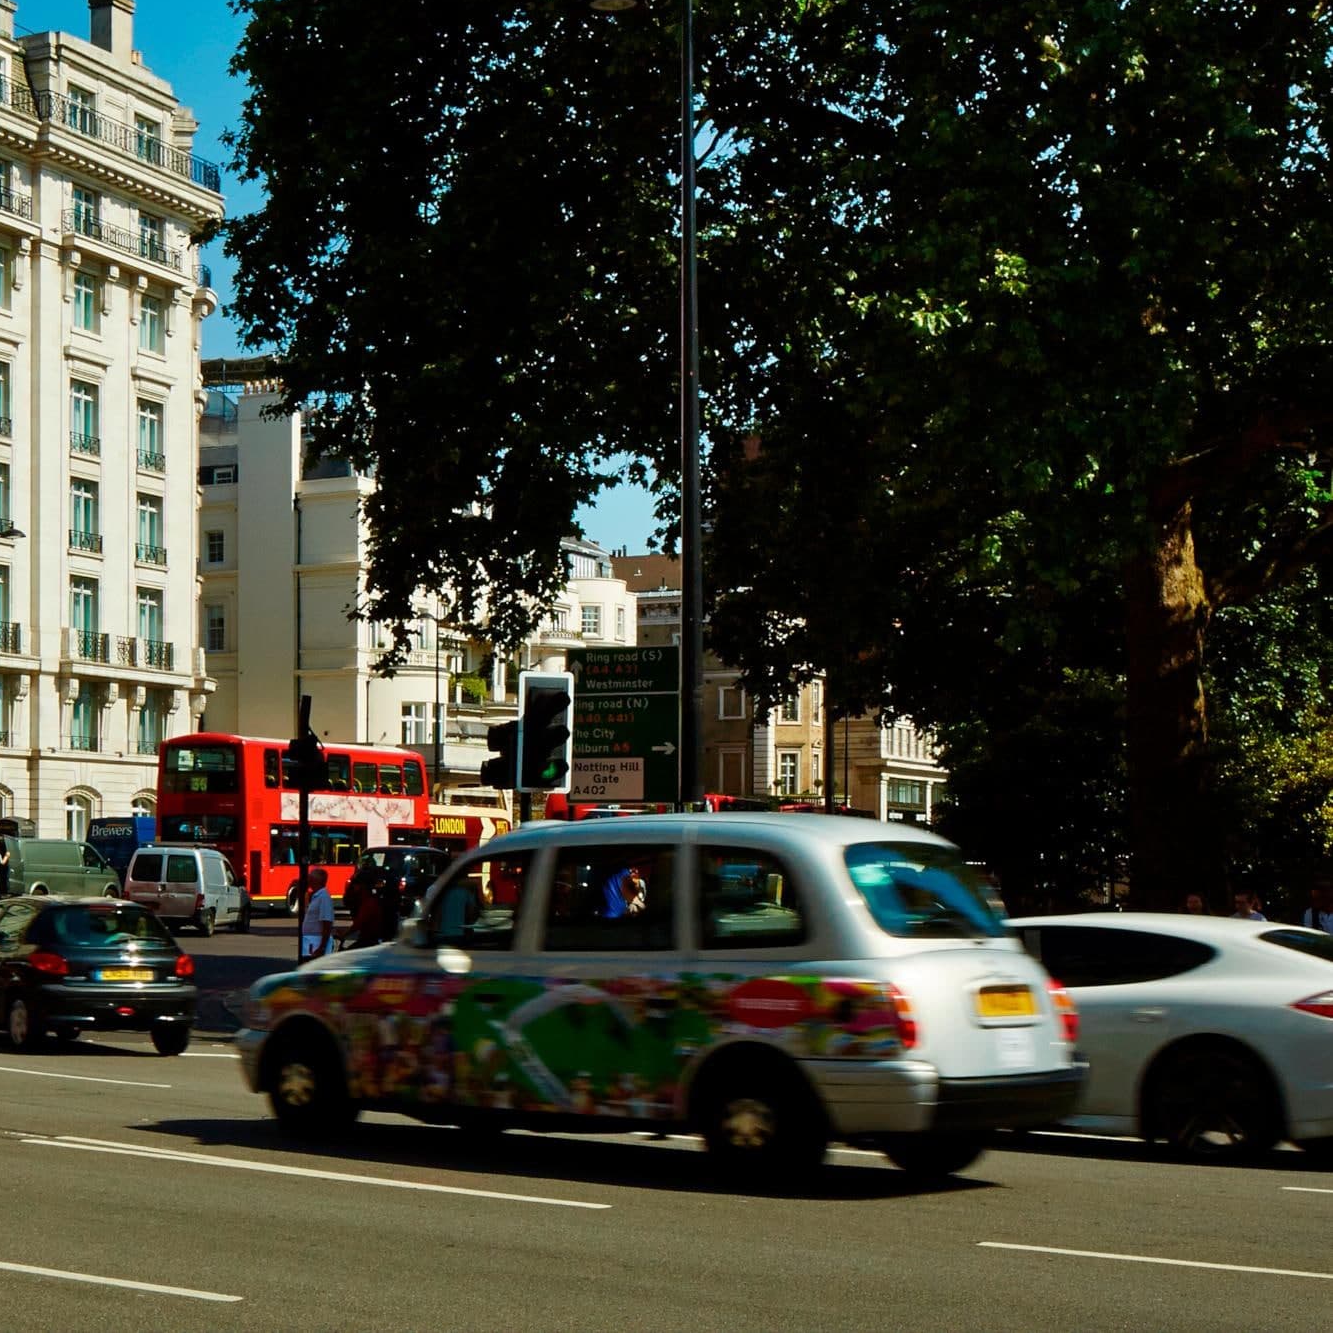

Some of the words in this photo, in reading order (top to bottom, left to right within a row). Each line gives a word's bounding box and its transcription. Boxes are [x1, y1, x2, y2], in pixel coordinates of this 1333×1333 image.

[586, 652, 610, 664] Ring
[614, 651, 638, 662] road
[642, 650, 663, 662] (S)
[586, 678, 654, 689] Westminster
[598, 698, 623, 708] road
[626, 697, 649, 709] (N)
[592, 728, 615, 740] City
[574, 762, 616, 773] Notting
[620, 762, 639, 772] Hill
[593, 774, 619, 784] Gate
[573, 785, 606, 795] A402
[92, 824, 133, 837] Brewers
[435, 817, 466, 835] LONDON
